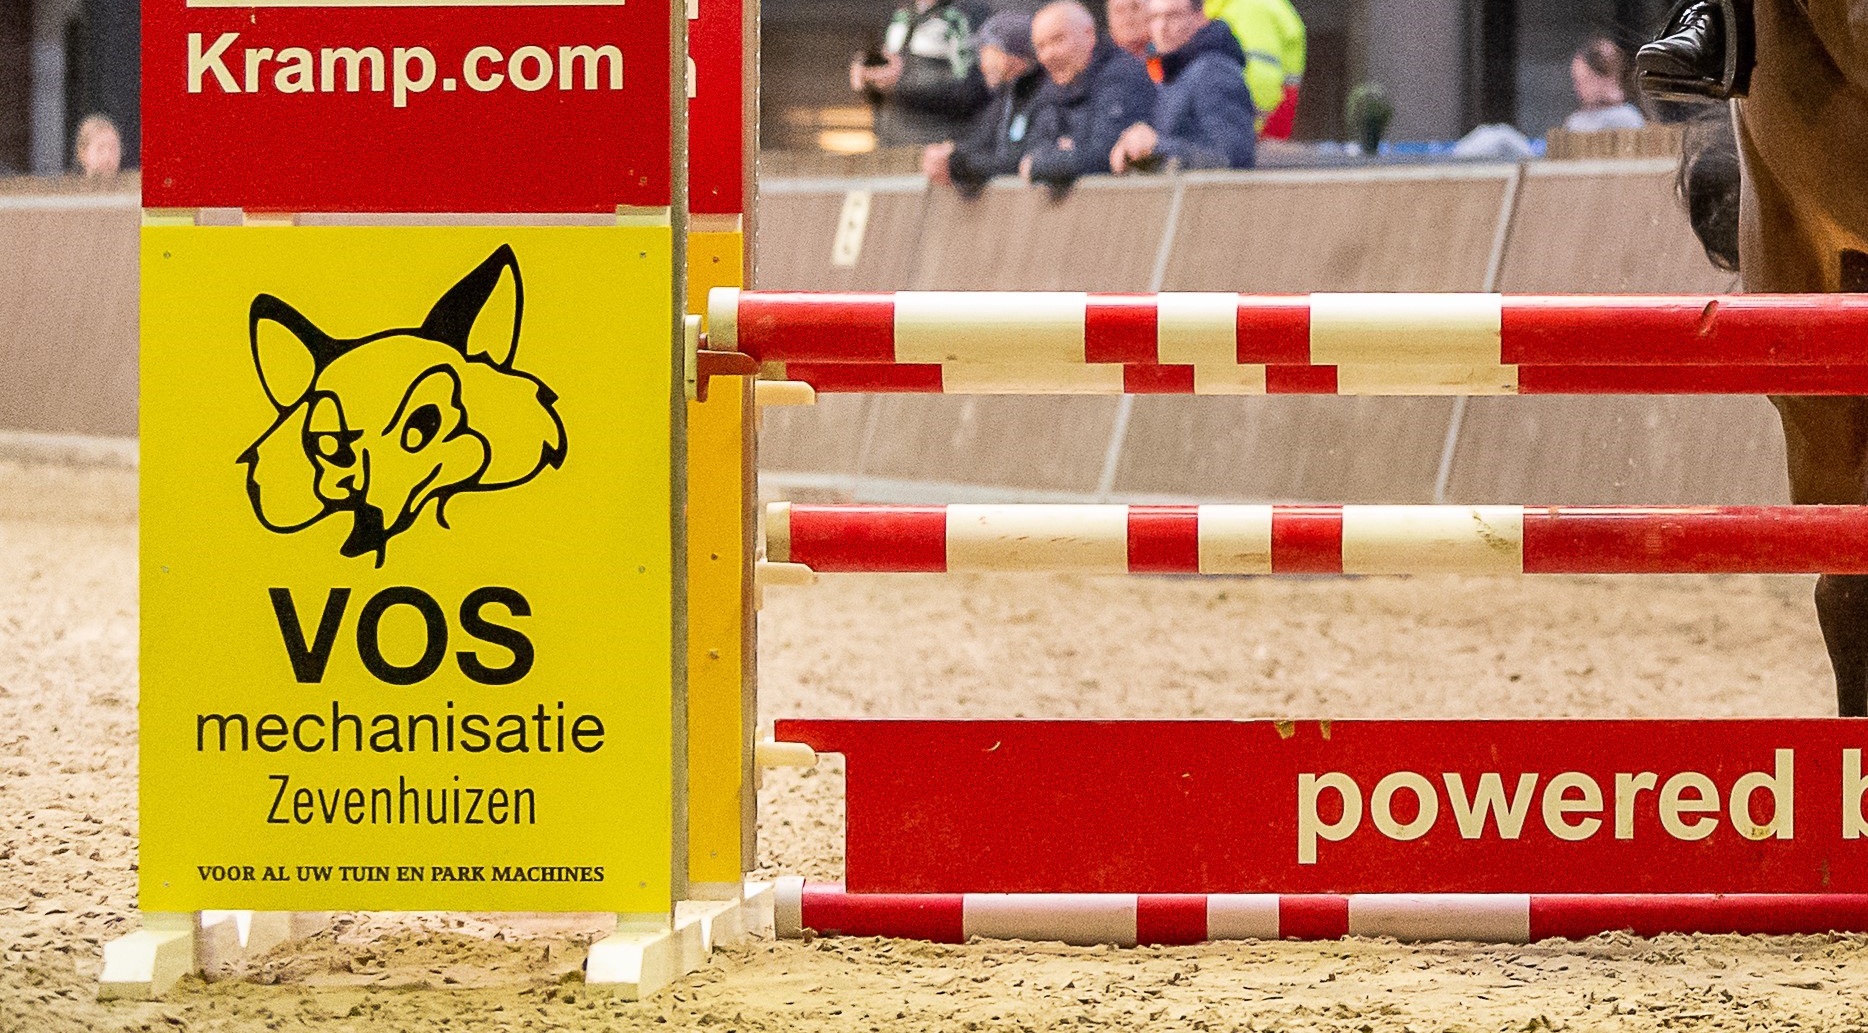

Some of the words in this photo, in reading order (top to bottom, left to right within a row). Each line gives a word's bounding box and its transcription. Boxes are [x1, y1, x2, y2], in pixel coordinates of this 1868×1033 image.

[187, 32, 624, 108] Kramp.com
[268, 585, 535, 686] VOS
[196, 700, 606, 754] mechanisatie
[266, 774, 536, 825] Zevenhuizen
[1297, 748, 1794, 864] powered
[197, 865, 256, 882] VOOR
[262, 866, 290, 882] AL
[295, 866, 333, 882] UW
[338, 866, 390, 882] TUIN
[396, 866, 425, 882] EN
[430, 866, 486, 882] PARK
[491, 866, 605, 882] MACHINES
